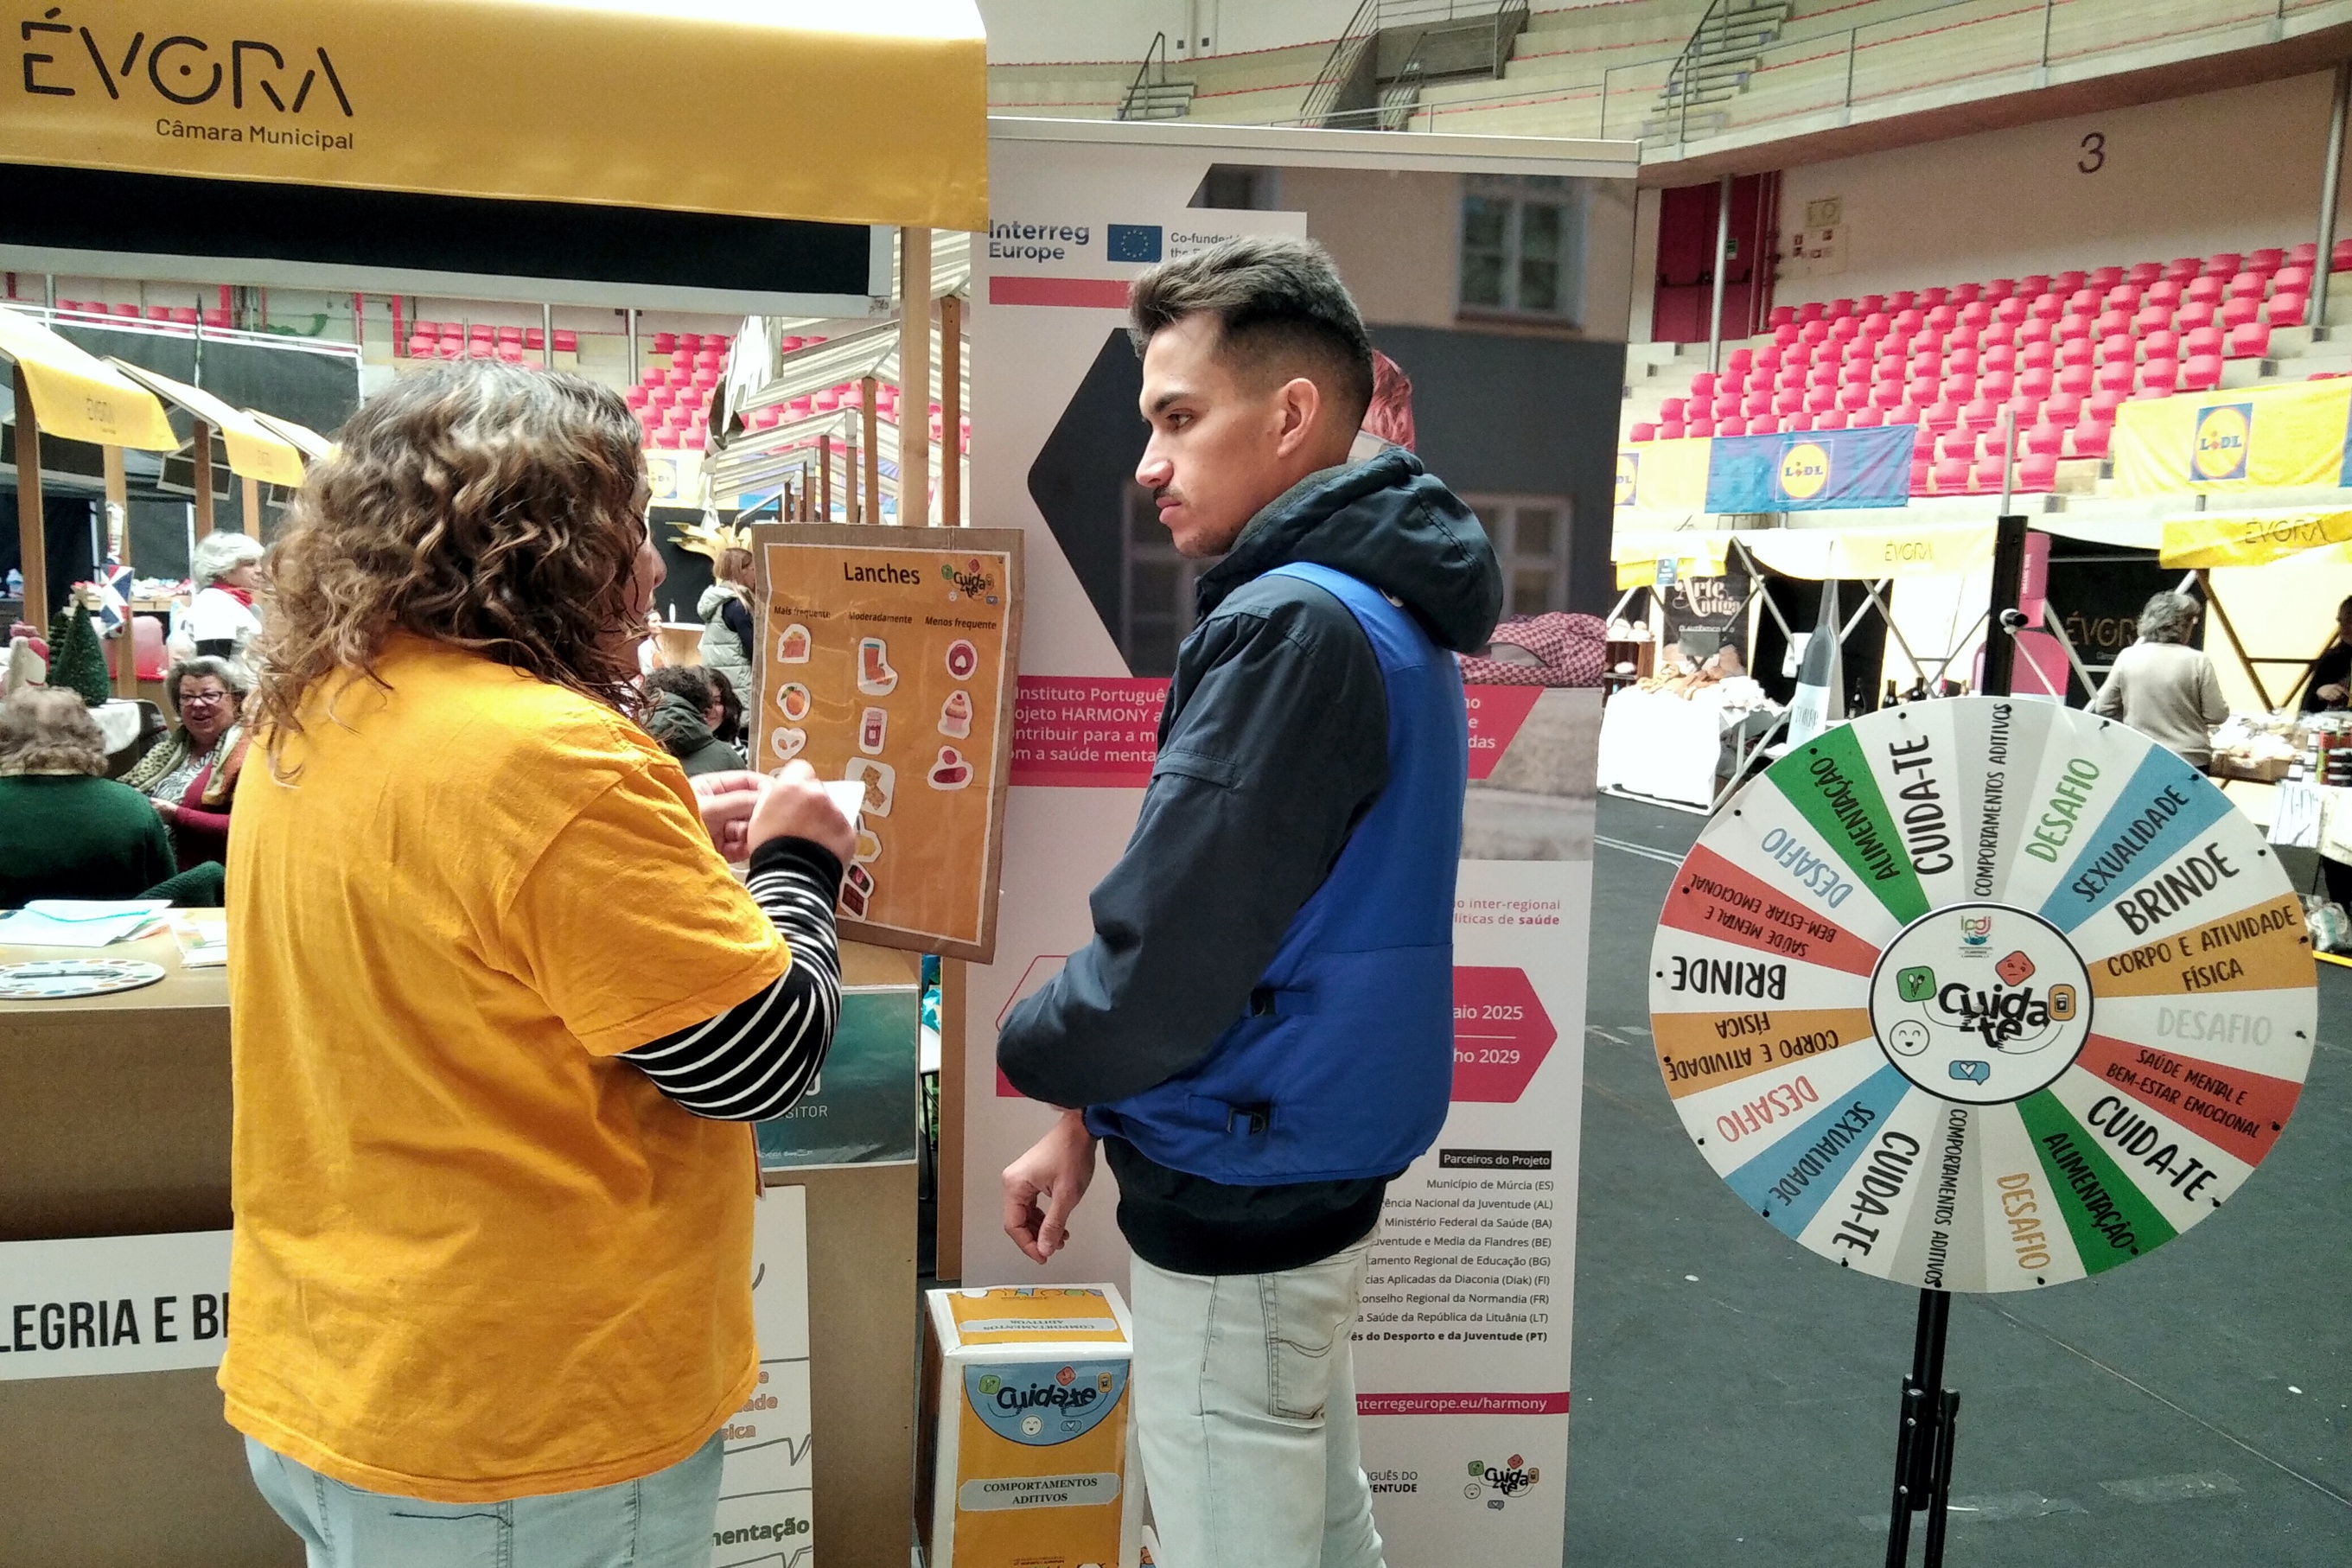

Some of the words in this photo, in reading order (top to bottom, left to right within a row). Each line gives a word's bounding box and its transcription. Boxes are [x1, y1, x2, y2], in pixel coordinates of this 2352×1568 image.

[22, 7, 354, 117] ÉVORA
[156, 118, 243, 143] Câmara
[250, 125, 354, 151] Municipal
[2077, 132, 2106, 174] 3
[989, 220, 1090, 245] Interreg
[989, 242, 1065, 263] Europe
[2200, 430, 2242, 450] LIDL
[1785, 462, 1824, 476] LIDL
[2245, 518, 2328, 544] ÉVORA
[844, 562, 921, 585] Lanches
[774, 606, 792, 615] Mais
[794, 607, 831, 619] frequente
[849, 610, 912, 624] Moderadamente
[925, 616, 953, 628] Menos
[954, 617, 997, 630] frequente
[1062, 707, 1149, 722] HARMONY
[1084, 730, 1120, 744] para
[1125, 731, 1135, 742] a
[1140, 731, 1157, 743] m
[1988, 704, 2011, 765] ADITIVOS
[1036, 749, 1045, 760] a
[1050, 746, 1099, 762] saúde
[1809, 756, 1901, 881] ALIMENTAÇÃO
[1889, 734, 1954, 876] CUIDA-TE
[2024, 758, 2100, 863] DESAFIO
[1974, 772, 2005, 896] COMPORTAMENTOS
[2072, 785, 2189, 903] SEXUALIDADE
[1761, 827, 1854, 909] DESAFIO
[1691, 873, 1762, 914] EMOCIONAL
[2113, 842, 2240, 936] BRINDE
[1469, 898, 1560, 913] inter-regional
[1705, 905, 1715, 920] E
[1498, 915, 1514, 925] de
[1519, 915, 1559, 925] saúde
[1718, 910, 1762, 939] MENTAL
[1766, 905, 1837, 942] BEM-ESTAR
[1765, 929, 1809, 957] SAÚDE
[2107, 942, 2171, 978] CORPO
[2178, 936, 2193, 957] E
[2202, 905, 2298, 951] ATIVIDADE
[1671, 956, 1786, 1000] BRINDE
[2183, 958, 2244, 991] FÍSICA
[1482, 1005, 1523, 1020] 2025
[1938, 983, 2050, 1027] Cuida
[1714, 1011, 1771, 1039] FÍSICA
[2157, 1006, 2272, 1047] DESAFIO
[1479, 1049, 1520, 1064] 2029
[1762, 1043, 1773, 1061] E
[1780, 1029, 1839, 1058] CORPO
[1668, 1047, 1751, 1081] ATIVIDADE
[2136, 1049, 2183, 1079] SAÚDE
[2184, 1068, 2234, 1104] MENTAL
[2235, 1090, 2247, 1106] E
[1716, 1075, 1820, 1143] DESAFIO
[2106, 1062, 2181, 1104] BEM-ESTAR
[2183, 1099, 2260, 1138] EMOCIONAL
[1444, 1154, 1493, 1164] Parceiros
[1495, 1155, 1509, 1165] do
[1512, 1156, 1550, 1167] Projeto
[1769, 1100, 1876, 1207] SEXUALIDADE
[2087, 1095, 2218, 1202] CUIDA-TE
[1935, 1108, 1967, 1226] COMPORTAMENTOS
[1426, 1179, 1477, 1190] Município
[1480, 1180, 1494, 1189] de
[1497, 1180, 1532, 1190] Múrcia
[1535, 1182, 1554, 1192] (ES)
[1832, 1131, 1921, 1256] CUIDA-TE
[2043, 1132, 2135, 1249] ALIMENTAÇÃO
[1383, 1198, 1412, 1209] ência
[1415, 1199, 1459, 1208] Nacional
[1463, 1199, 1476, 1208] da
[1477, 1200, 1531, 1209] Juventude
[1534, 1200, 1553, 1210] (AL)
[1385, 1217, 1436, 1227] Ministério
[1439, 1217, 1477, 1227] Federal
[1481, 1218, 1494, 1227] da
[1497, 1217, 1528, 1228] Saúde
[1532, 1219, 1552, 1229] (BA)
[1996, 1172, 2051, 1270] DESAFIO
[1433, 1236, 1465, 1246] Media
[1469, 1237, 1481, 1246] da
[1484, 1237, 1528, 1247] Flandres
[1532, 1238, 1552, 1248] (BE)
[1414, 1256, 1458, 1267] Regional
[1461, 1256, 1474, 1265] de
[1476, 1256, 1527, 1268] Educação
[1528, 1257, 1551, 1267] (BG)
[1925, 1230, 1949, 1285] ADITIVOS
[1387, 1275, 1436, 1286] Aplicadas
[1438, 1275, 1451, 1284] da
[1455, 1275, 1500, 1284] Diaconia
[1502, 1275, 1532, 1286] (Diak)
[1534, 1276, 1550, 1286] (FI)
[1358, 1294, 1403, 1303] onselho
[1406, 1294, 1450, 1305] Regional
[1452, 1294, 1465, 1303] da
[1469, 1294, 1527, 1303] Normandia
[1529, 1295, 1549, 1305] (FR)
[155, 1296, 178, 1344] E
[1367, 1313, 1399, 1323] Saúde
[1401, 1313, 1414, 1322] da
[1418, 1312, 1467, 1323] República
[1469, 1313, 1482, 1323] da
[1486, 1312, 1527, 1323] Lituânia
[1529, 1314, 1548, 1323] (LT)
[1367, 1331, 1380, 1341] do
[1383, 1332, 1435, 1342] Desporto
[1447, 1331, 1462, 1341] da
[1463, 1331, 1523, 1342] Juventude
[1526, 1332, 1547, 1342] (PT)
[984, 1477, 1098, 1492] COMPORTAMENTOS
[1402, 1471, 1418, 1481] DO
[1484, 1468, 1528, 1486] Cuida
[1012, 1493, 1068, 1505] ADITIVOS
